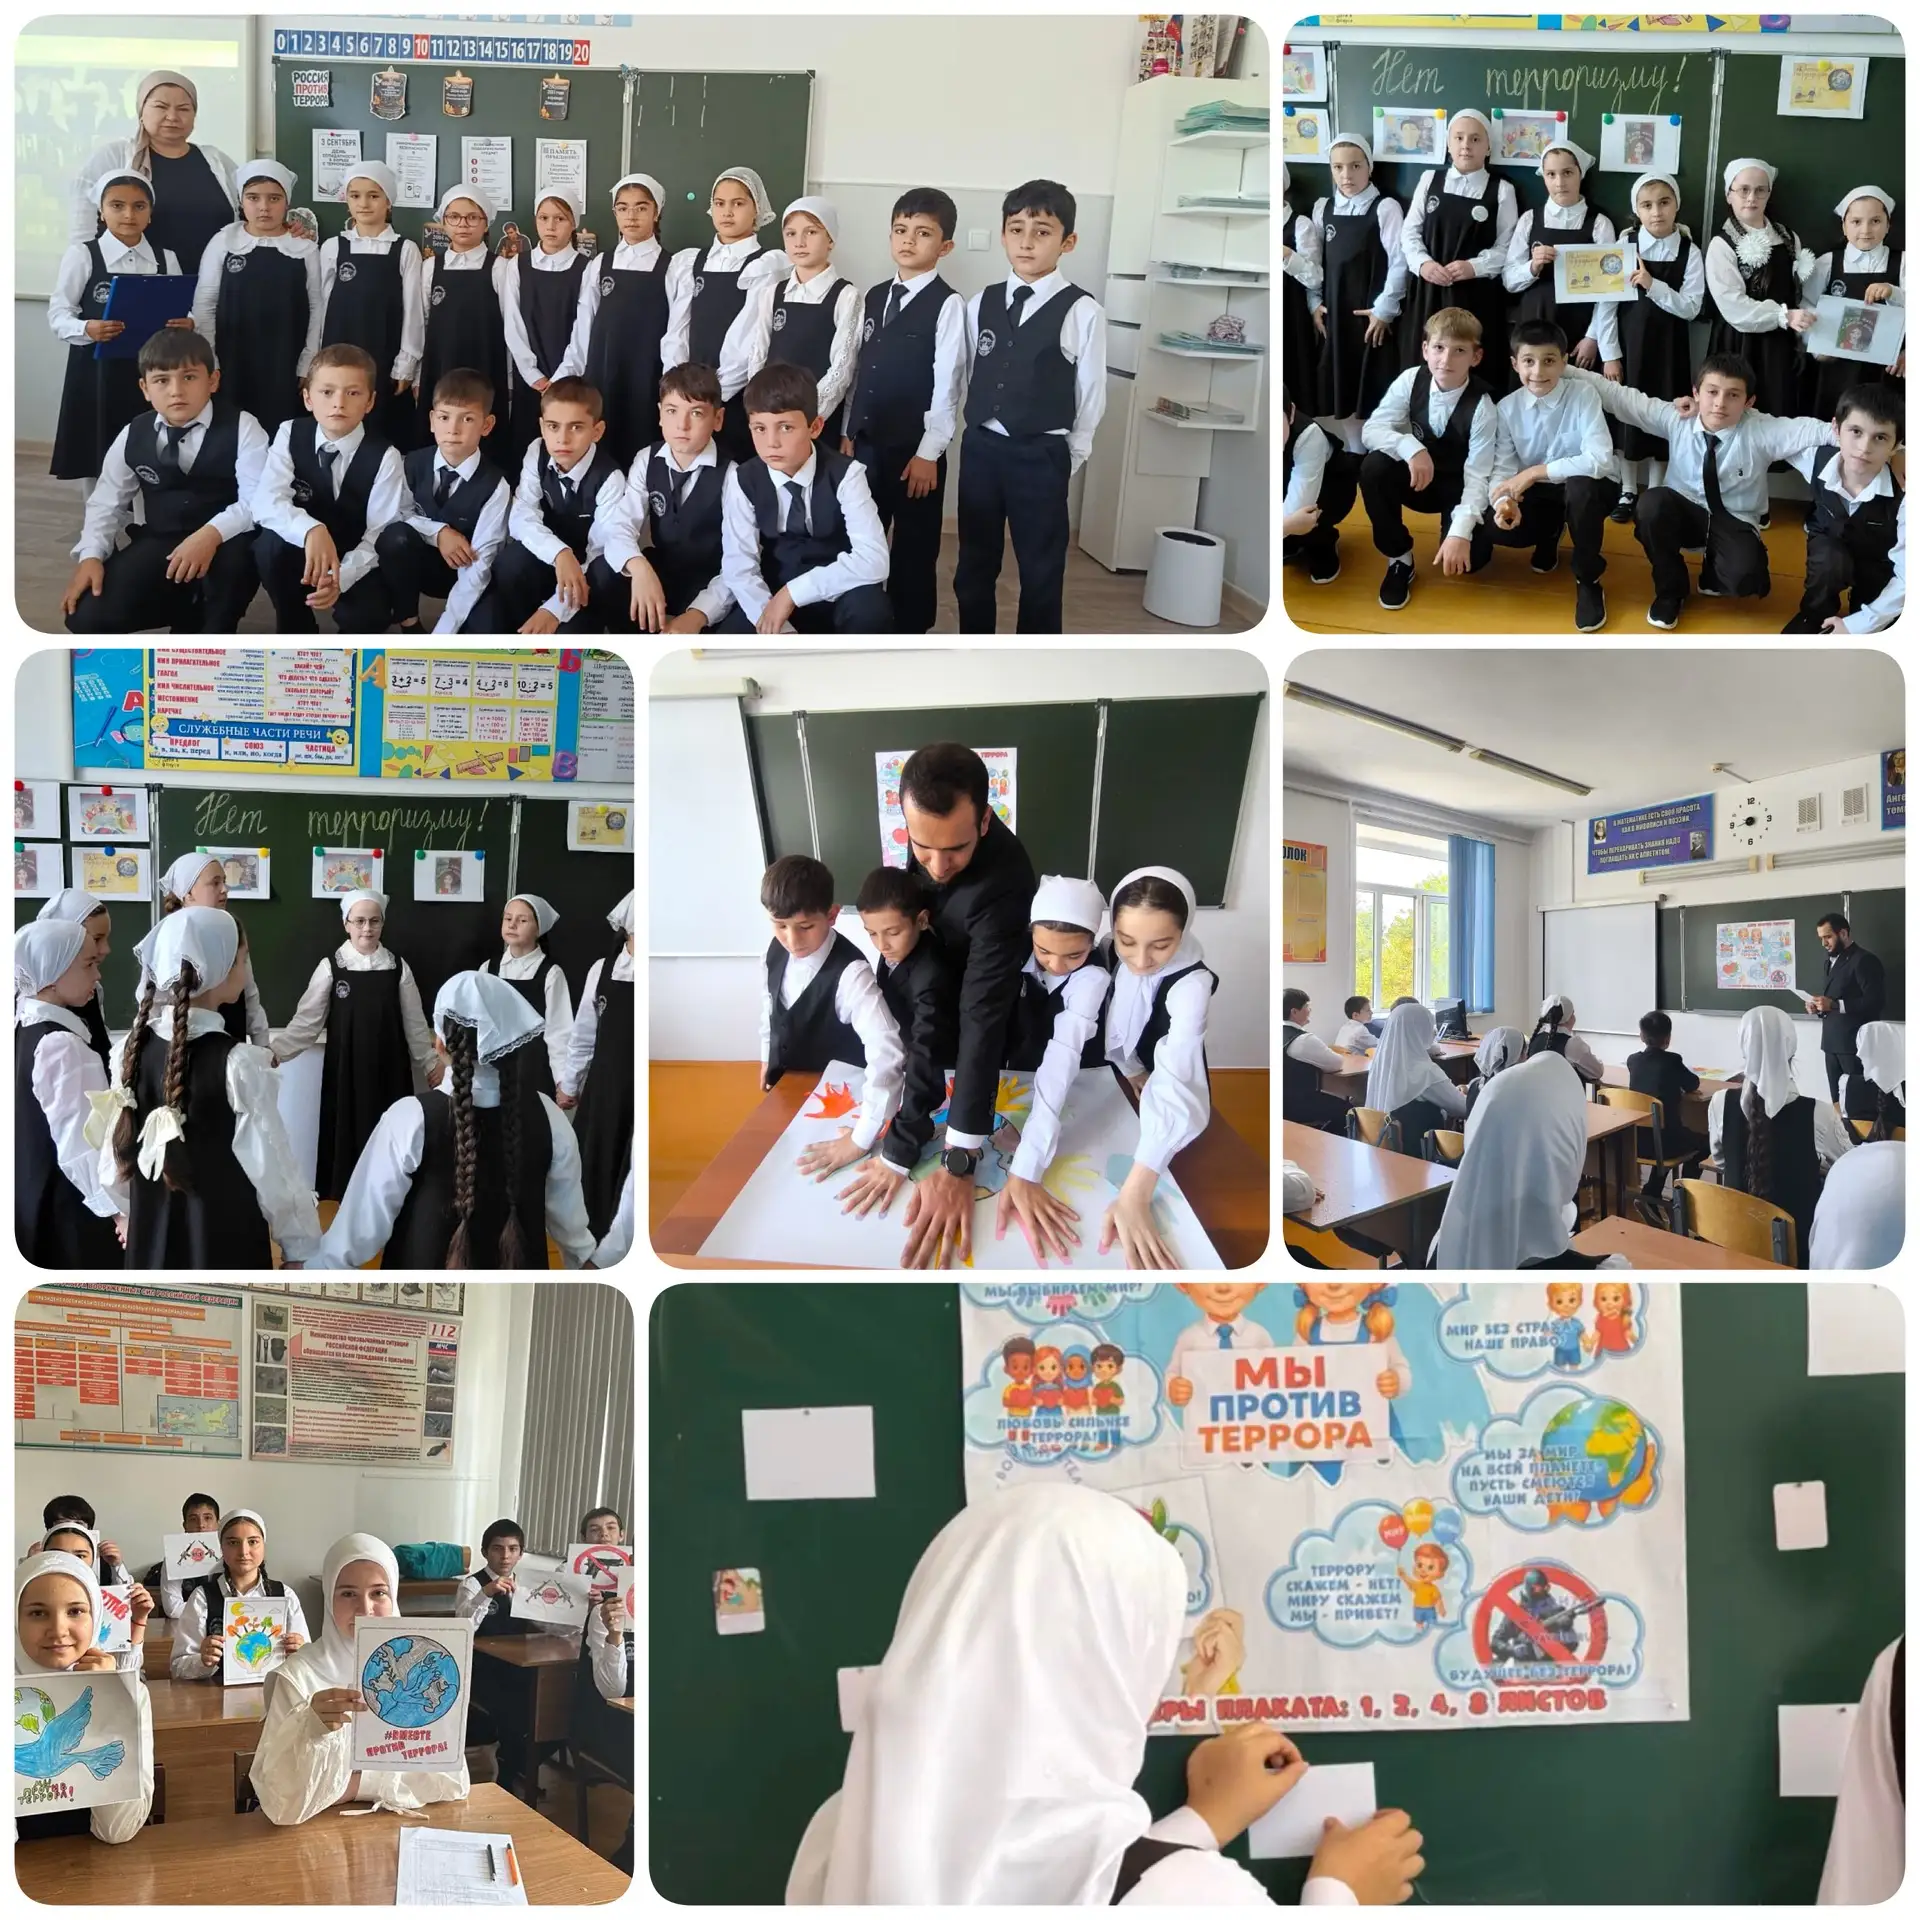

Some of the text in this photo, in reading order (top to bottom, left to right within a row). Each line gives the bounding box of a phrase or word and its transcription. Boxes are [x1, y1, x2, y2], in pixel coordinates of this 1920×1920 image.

[276, 34, 588, 62] 0 1 2 3 4 5 6 7 8 9 10 11 12 13 14 15 16 17 18 19 20
[294, 72, 328, 82] РОССИЯ
[1372, 48, 1445, 96] Нет
[296, 84, 328, 94] ПРОТИВ
[292, 94, 329, 106] ТЕРРОРА
[448, 678, 453, 686] 3
[158, 695, 198, 703] МЕСТОИМЕНИЕ
[178, 724, 321, 739] СЛУЖЕБНЫЕ ЧАСТИ РЕЧИ
[170, 738, 200, 747] ПРЕДЛОГ
[305, 744, 336, 753] ЧАСТИЦА
[190, 748, 210, 758] перед
[1747, 797, 1755, 805] 12
[195, 791, 268, 837] Нет
[88, 1283, 140, 1294] ВООРУЖЕННЫХ
[142, 1288, 154, 1296] СИЛ
[156, 1290, 200, 1300] РОССИЙСКОЙ
[201, 1295, 239, 1306] ФЕДЕРАЦИИ
[984, 1286, 1012, 1297] МЫ
[1106, 1283, 1142, 1293] МИР!
[432, 1324, 456, 1338] 112
[1446, 1324, 1478, 1337] МИР
[1485, 1323, 1509, 1335] БЕЗ
[310, 1331, 346, 1340] Министерство
[348, 1335, 385, 1345] чрезвычайных
[1465, 1338, 1504, 1350] НАШЕ
[303, 1348, 335, 1356] обращается
[326, 1342, 358, 1350] РОССИЙСКОЙ
[1235, 1356, 1326, 1390] МЫ
[1210, 1390, 1362, 1422] ПРОТИВ
[997, 1416, 1130, 1430] ЛЮБОВЬ СИЛЬНЕЕ
[1030, 1430, 1096, 1444] ТЕРРОРА!
[1198, 1421, 1373, 1454] ТЕРРОРА
[1485, 1448, 1512, 1460] МЫ
[1518, 1447, 1537, 1459] ЗА
[1461, 1460, 1523, 1476] НА ВСЕЙ
[1470, 1479, 1516, 1492] ПУСТЬ
[1484, 1494, 1526, 1506] НАШИ
[1311, 1564, 1375, 1576] ТЕРРОРУ
[1286, 1578, 1400, 1592] СКАЖЕМ НЕТ!
[1288, 1593, 1401, 1608] МИРУ СКАЖЕМ
[1290, 1608, 1399, 1621] МЫ ПРИВЕТ!
[1565, 1664, 1632, 1678] ТЕРРОРА!
[1216, 1696, 1350, 1720] ПЛАКАТА:
[1360, 1696, 1382, 1718] 1,
[1392, 1693, 1419, 1718] 2,
[1430, 1693, 1457, 1716] 4,
[1468, 1692, 1488, 1715] 8
[1498, 1688, 1608, 1712] ЛИСТОВ
[384, 1730, 431, 1740] #ВМЕСТЕ
[366, 1741, 406, 1757] ПРОТИВ
[401, 1741, 448, 1760] ТЕРРОРА!
